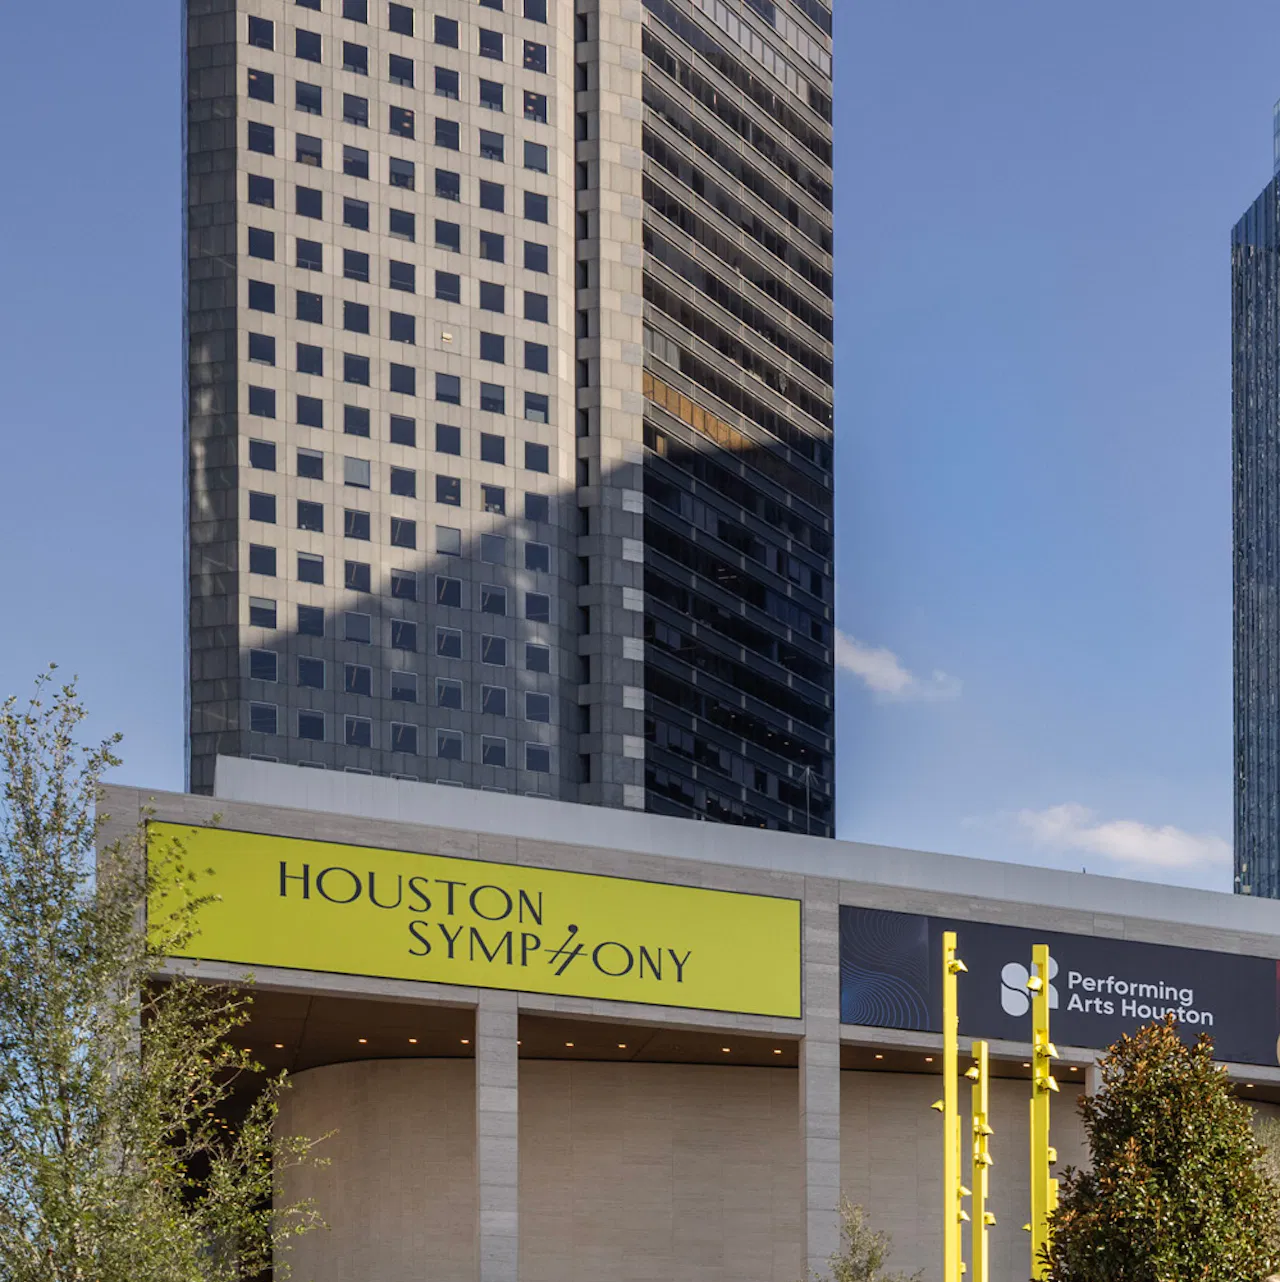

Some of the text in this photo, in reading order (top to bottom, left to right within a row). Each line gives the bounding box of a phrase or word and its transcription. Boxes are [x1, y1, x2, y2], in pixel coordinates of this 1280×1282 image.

[279, 860, 543, 926] HOUSTON
[408, 920, 692, 983] SYMPHONY
[1066, 993, 1214, 1026] Arts Houston
[1067, 970, 1194, 1007] Performing
